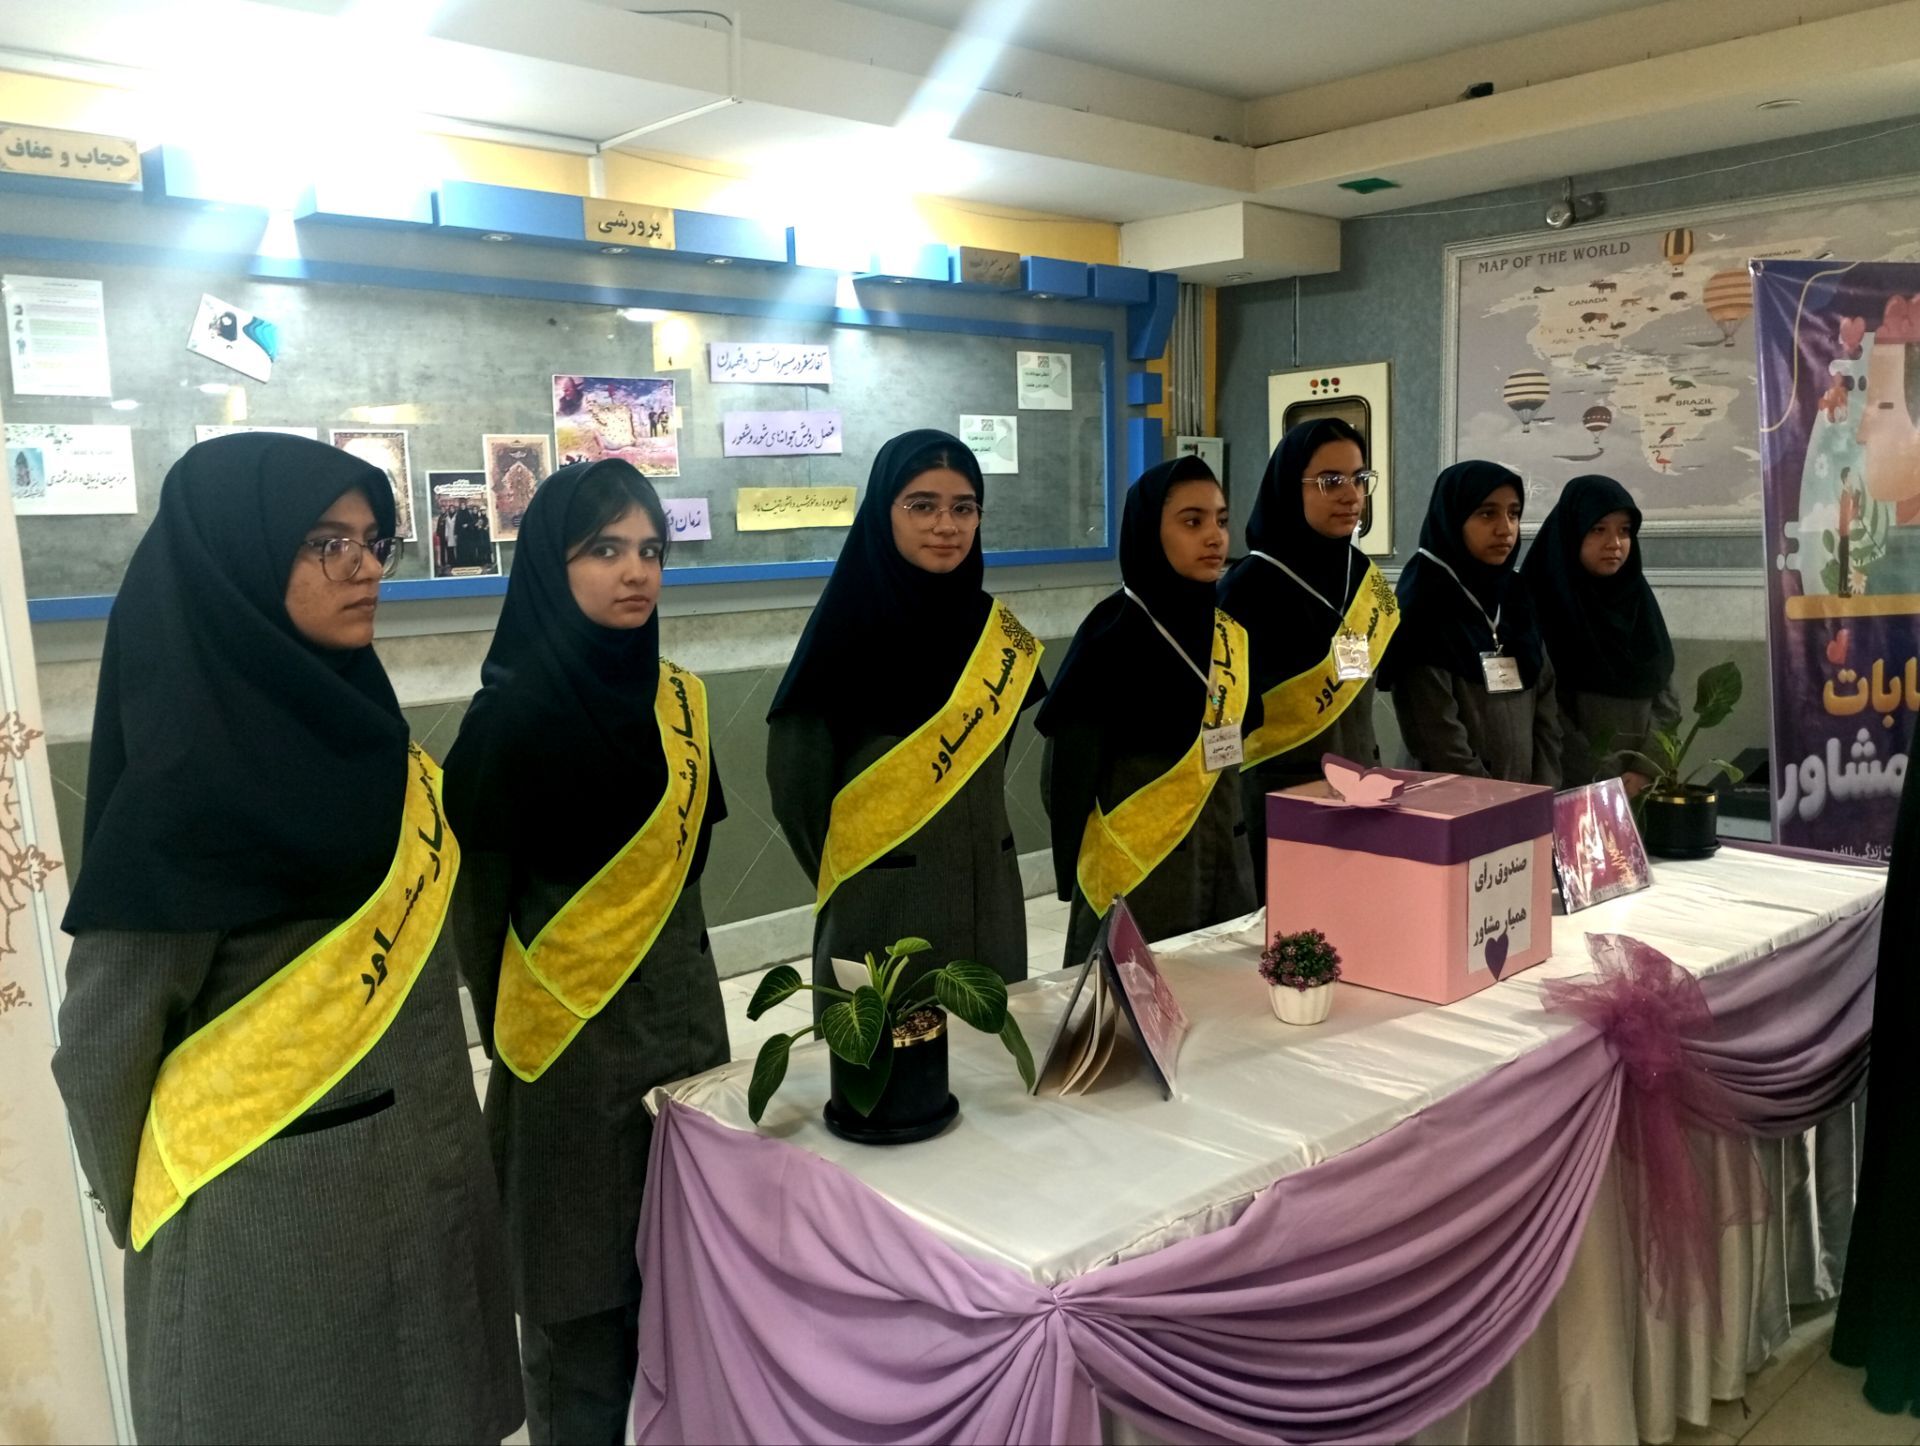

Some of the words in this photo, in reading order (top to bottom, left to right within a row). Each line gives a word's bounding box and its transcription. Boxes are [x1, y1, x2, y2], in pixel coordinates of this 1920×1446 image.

[5, 137, 53, 159] عفاف
[59, 151, 70, 168] و
[75, 146, 130, 171] حجاب
[597, 209, 663, 240] پرورشی
[1478, 258, 1509, 274] MAP
[1512, 255, 1533, 269] OF
[1537, 250, 1568, 265] THE
[1573, 241, 1631, 261] WORLD
[1567, 297, 1609, 306] CANADA
[1675, 398, 1714, 407] BRAZIL
[814, 420, 835, 449] فصل
[1213, 622, 1236, 686] همیار
[982, 647, 1017, 716] همیار
[1315, 676, 1345, 714] اور
[1822, 656, 1920, 729] ابات
[668, 676, 702, 761] همیار
[931, 706, 984, 784] مشاور
[1778, 727, 1909, 825] مشاور
[676, 758, 698, 862] مشاور
[418, 775, 448, 883] همیار
[1494, 856, 1528, 886] صندوق
[1473, 914, 1501, 947] مشاور
[1501, 906, 1527, 936] همیار
[360, 873, 425, 1006] مشاور
